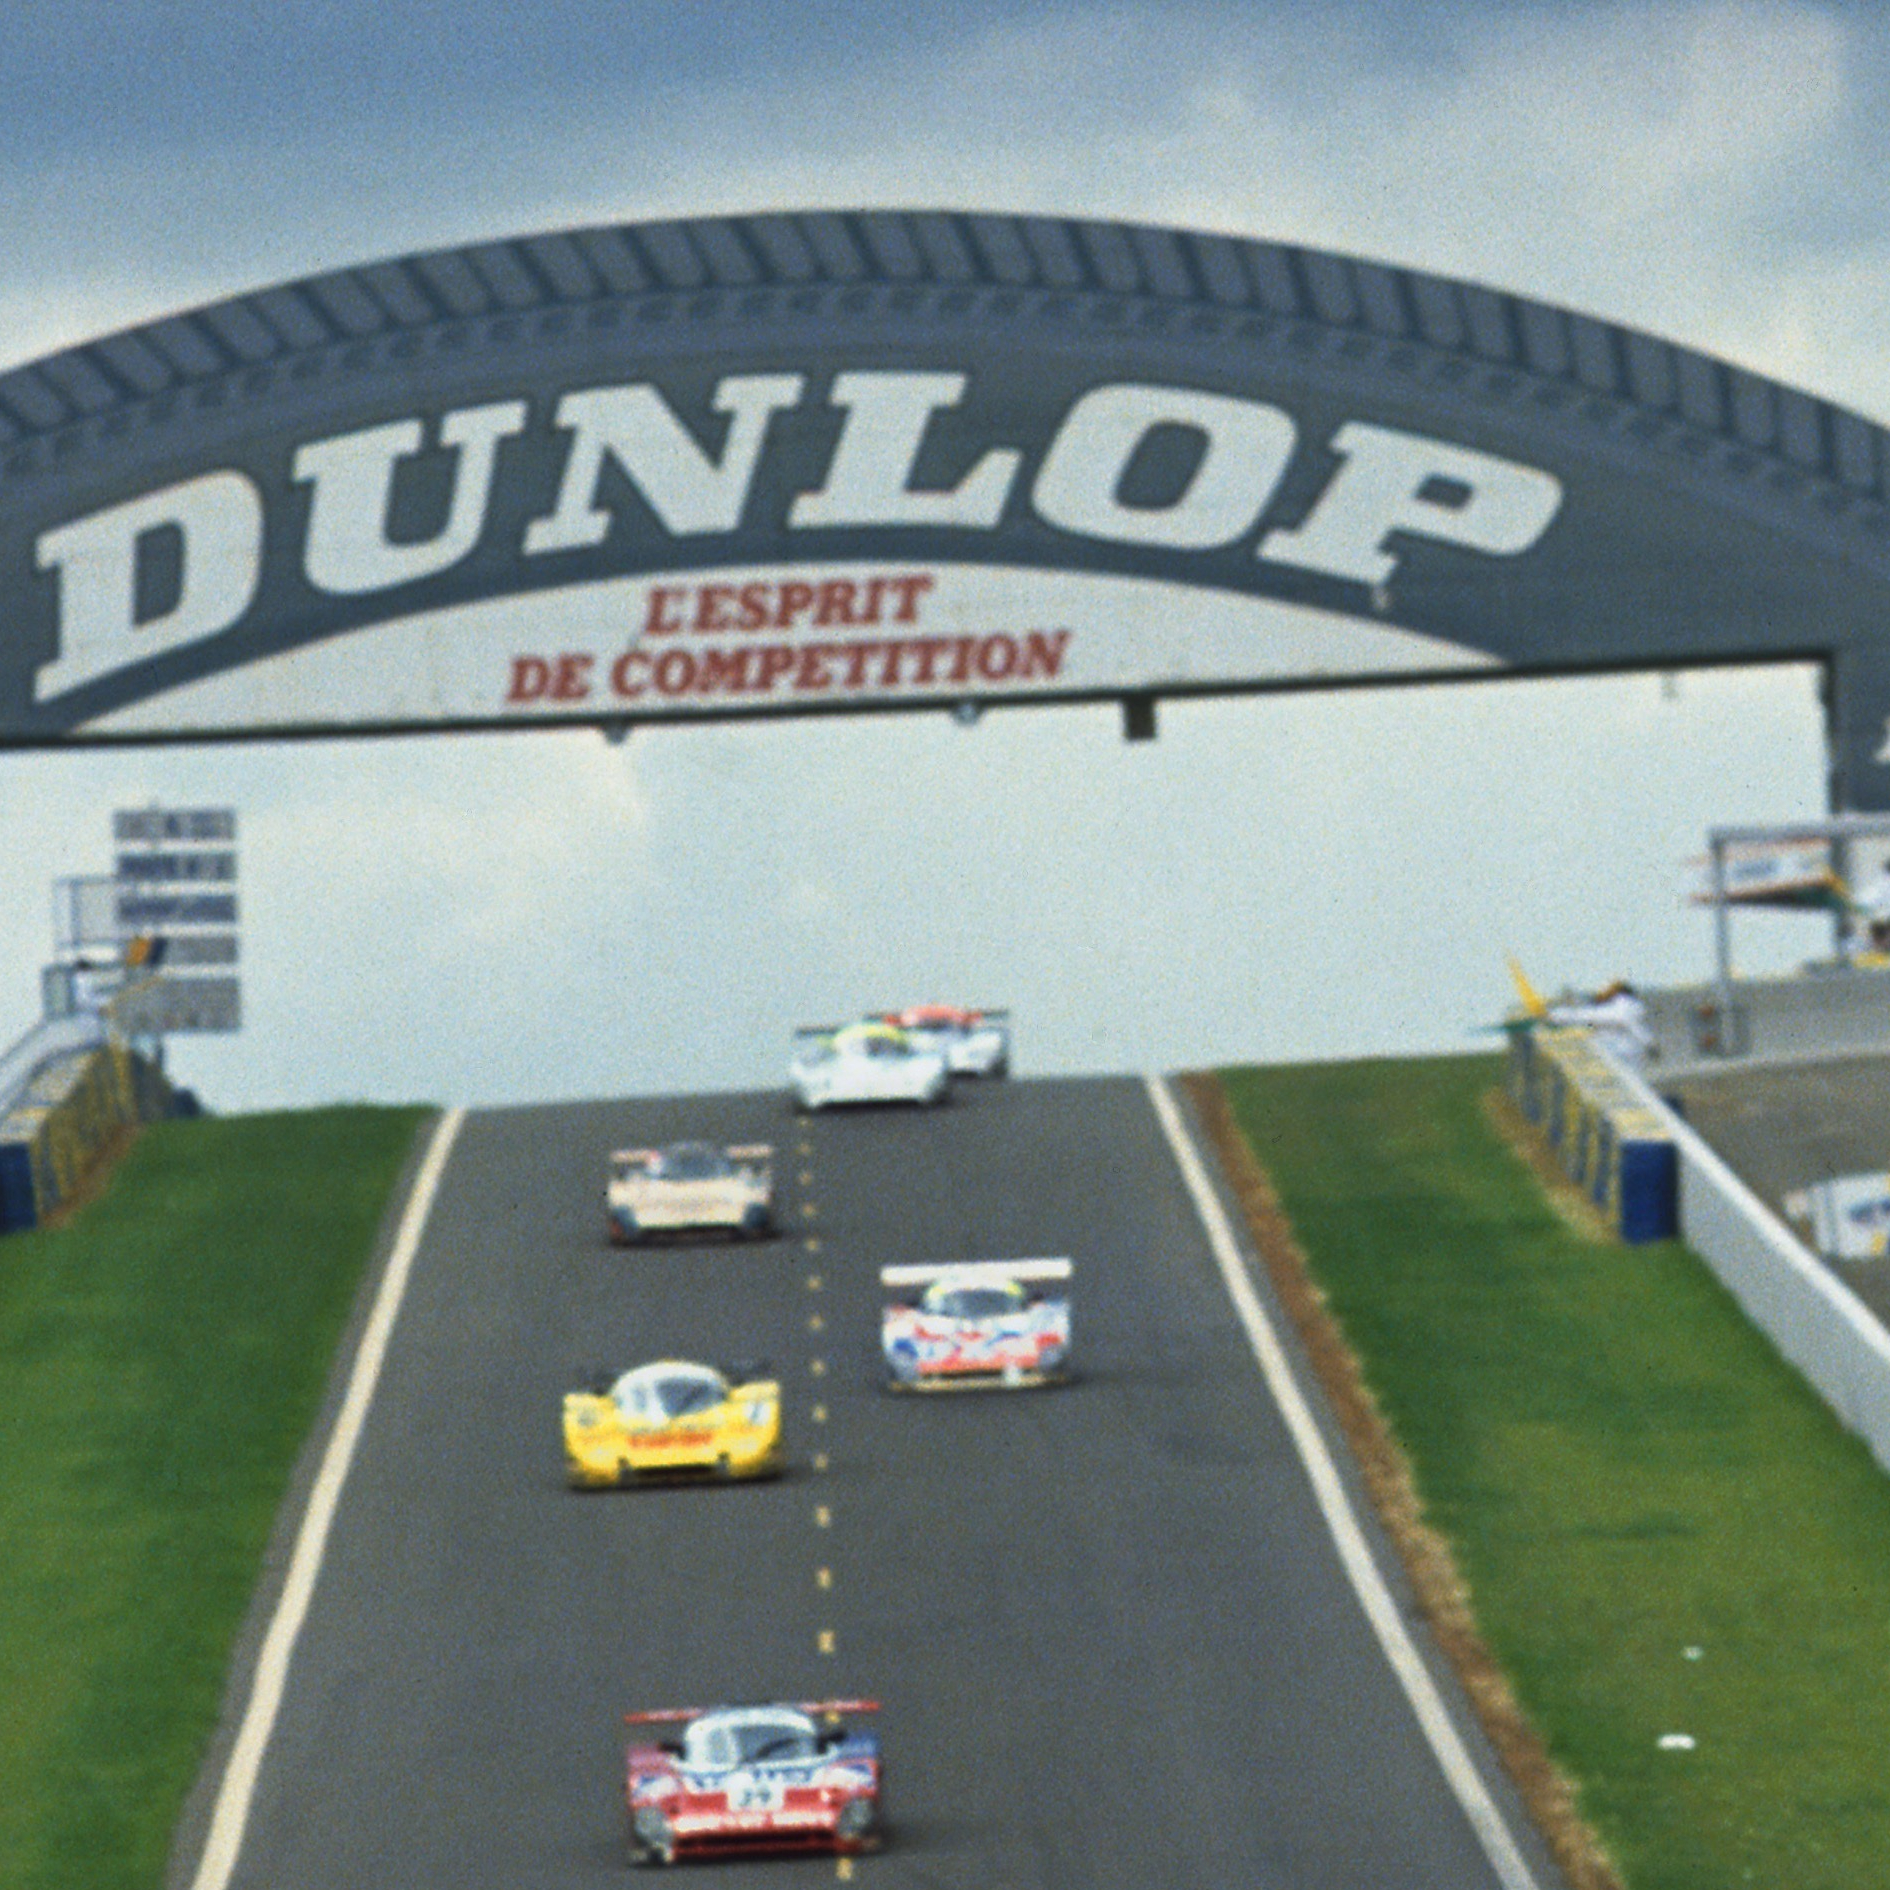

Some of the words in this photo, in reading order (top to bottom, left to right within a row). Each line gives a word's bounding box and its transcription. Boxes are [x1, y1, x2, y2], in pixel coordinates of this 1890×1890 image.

[34, 373, 1562, 702] DUNLOP
[645, 573, 933, 634] L'ESPRIT
[510, 653, 594, 700] DE
[610, 629, 1069, 696] COMPETITION
